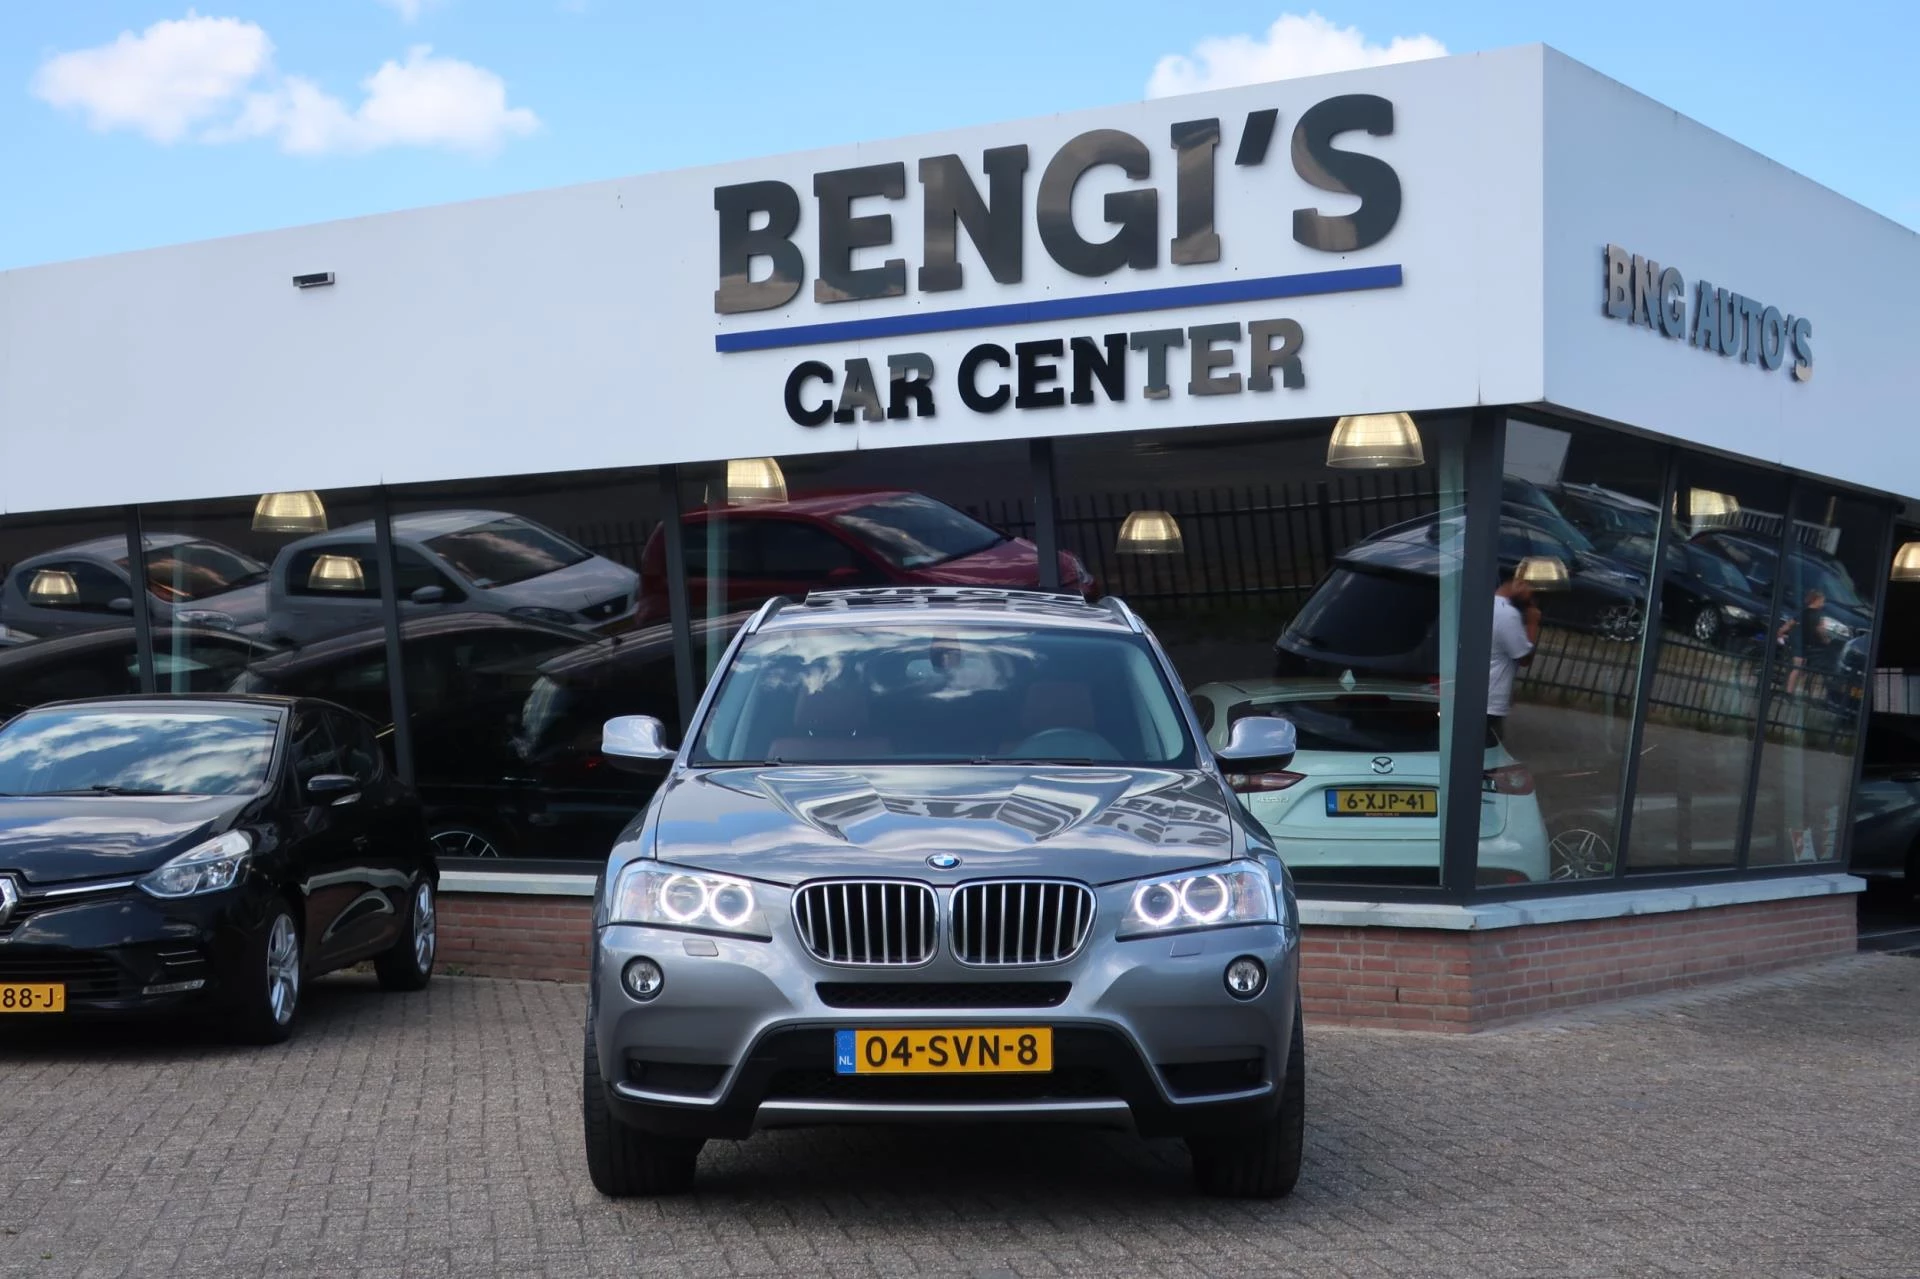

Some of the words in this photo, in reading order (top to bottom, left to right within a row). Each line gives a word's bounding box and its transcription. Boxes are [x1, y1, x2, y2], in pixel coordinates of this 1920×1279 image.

[714, 93, 1402, 314] BENGI'S
[1605, 243, 1686, 340] BNG
[1693, 279, 1813, 382] AUTO'S
[784, 352, 936, 427] CAR
[957, 318, 1305, 409] CENTER
[1347, 793, 1425, 810] 6-XJP-41
[838, 1056, 852, 1066] NL
[865, 1034, 1038, 1067] 04-SVN-8
